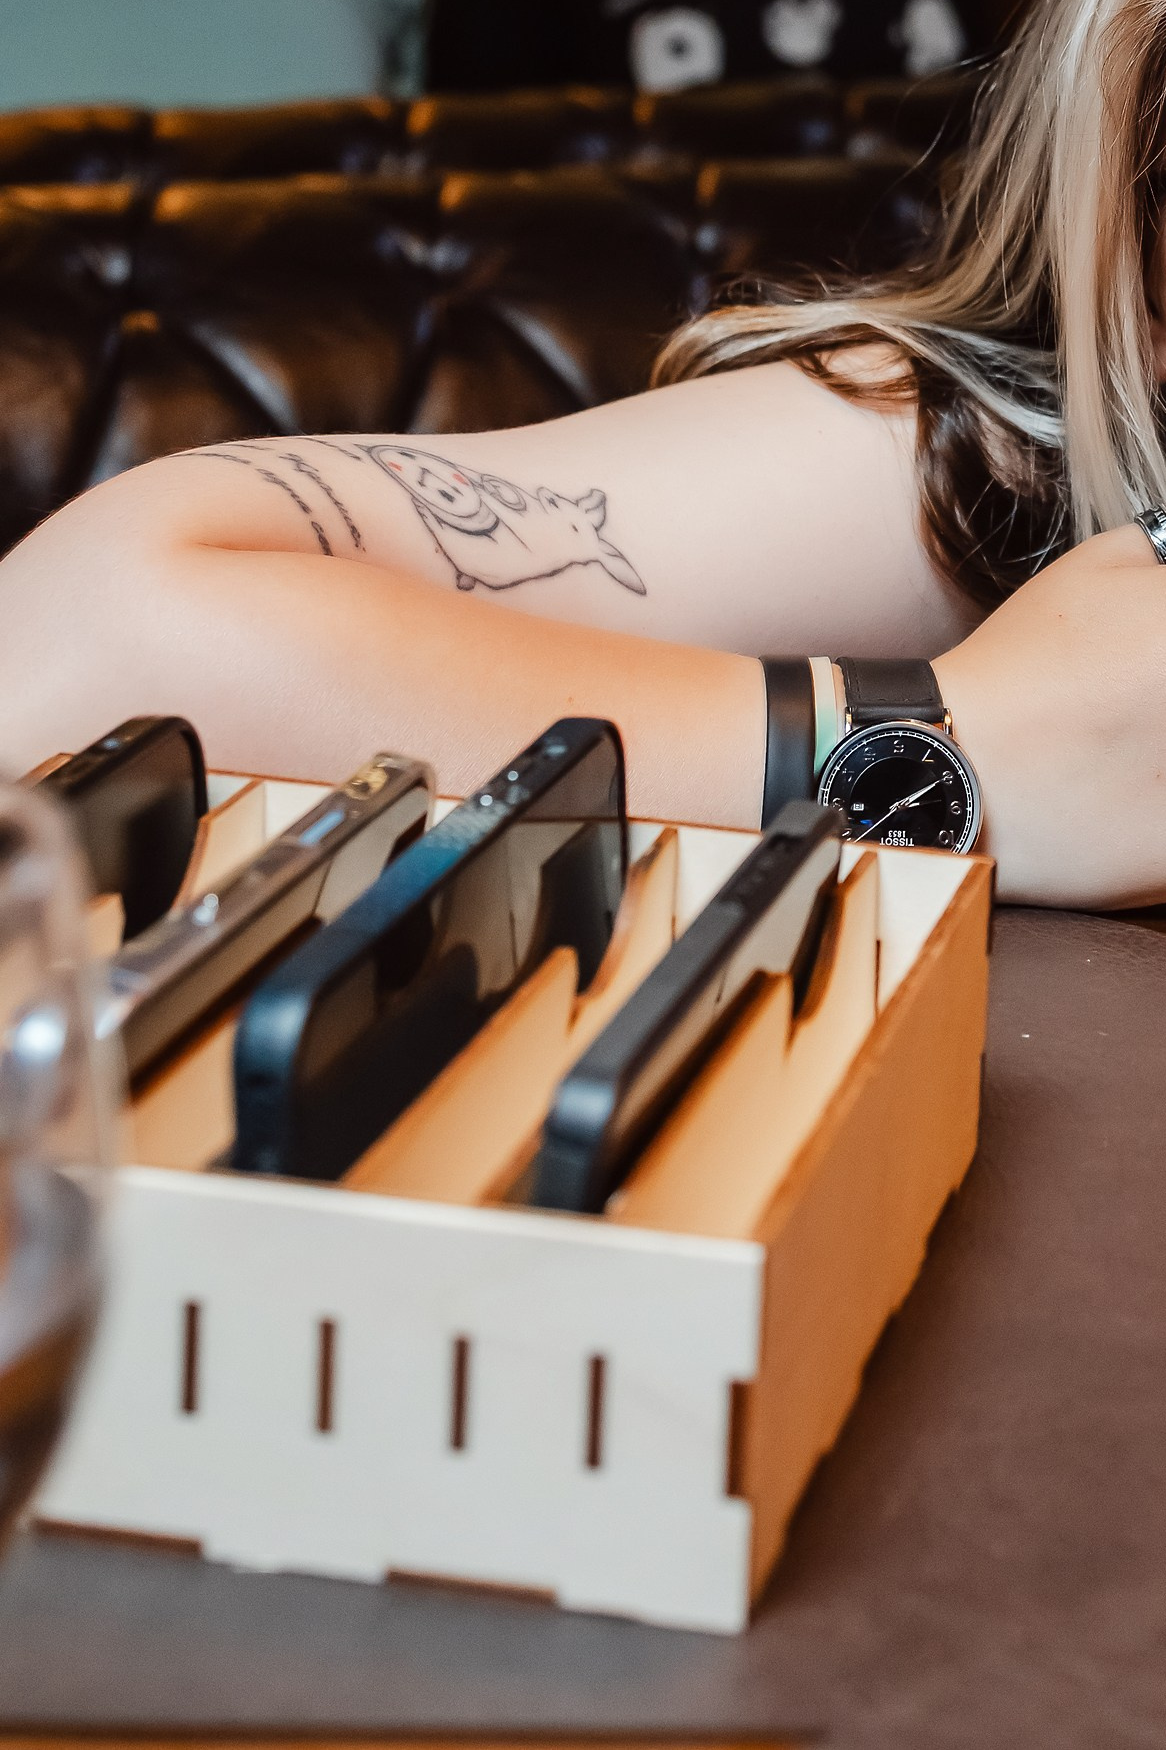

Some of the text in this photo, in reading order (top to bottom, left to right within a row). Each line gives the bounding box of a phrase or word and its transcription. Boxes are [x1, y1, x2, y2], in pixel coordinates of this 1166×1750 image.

[921, 748, 935, 763] 7
[888, 830, 906, 838] 1853
[880, 837, 915, 847] TISSOT
